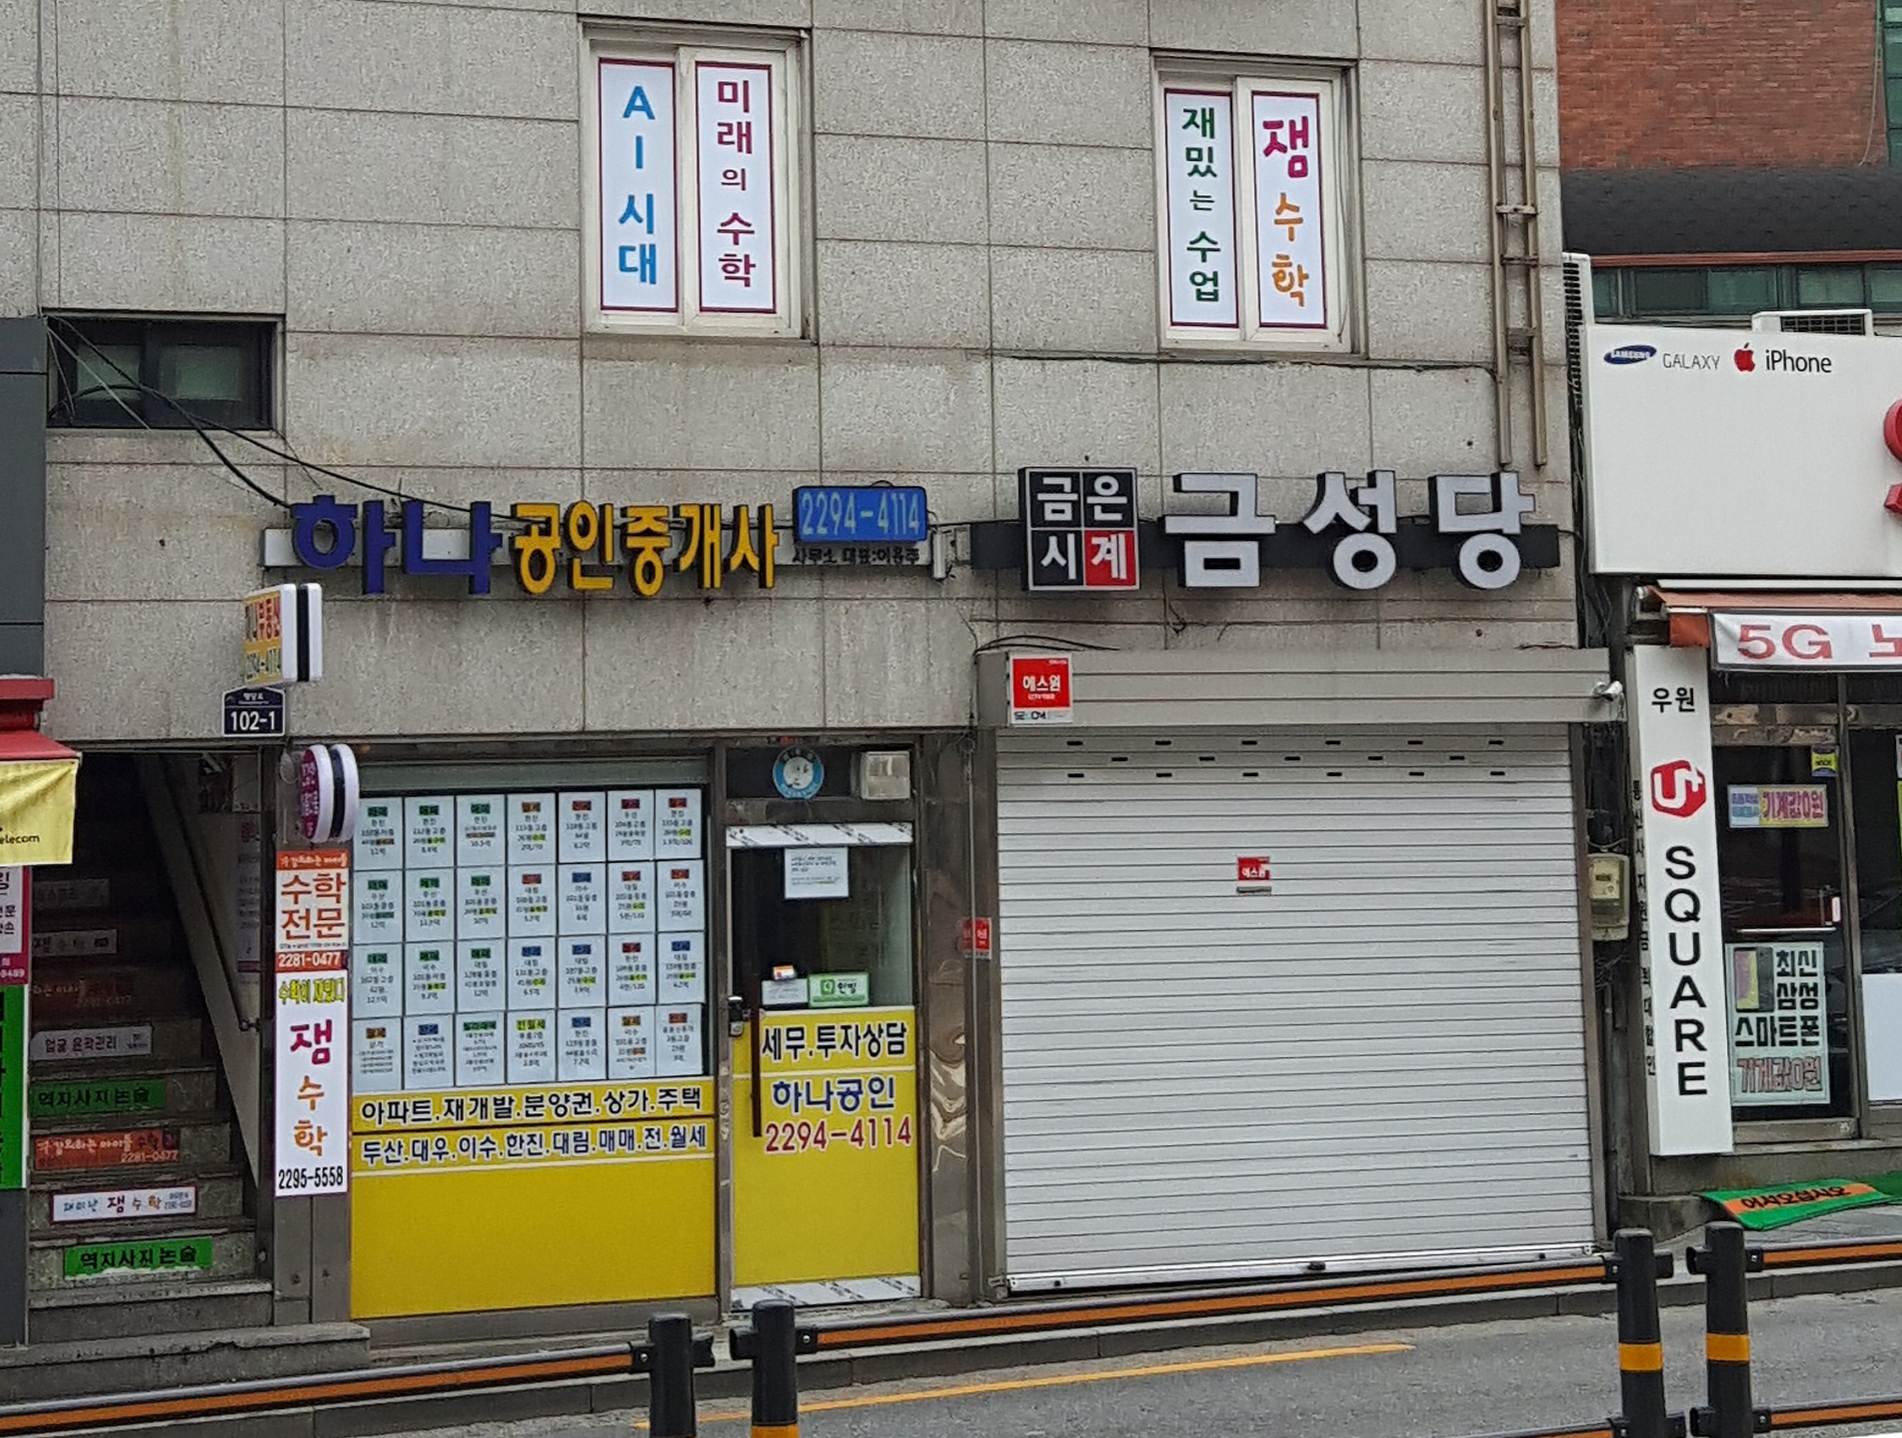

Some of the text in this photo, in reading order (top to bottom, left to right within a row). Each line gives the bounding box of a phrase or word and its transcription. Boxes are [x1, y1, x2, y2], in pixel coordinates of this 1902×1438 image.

[716, 79, 757, 288] 미래의 수학
[618, 193, 658, 286] 시대
[1186, 231, 1222, 303] 수업
[1662, 352, 1721, 371] GALAXY
[1765, 349, 1833, 374] iPhone
[801, 490, 921, 537] 2294-4114
[1036, 474, 1128, 523] 금은
[291, 493, 780, 598] 하나 공인중개사
[1158, 469, 1536, 590] 금성당
[1039, 532, 1129, 582] 시계
[1737, 623, 1833, 660] 5G
[1022, 674, 1061, 693] 에스원
[1651, 687, 1697, 714] 우원
[230, 710, 275, 732] 102-1
[280, 871, 347, 906] 수학
[280, 907, 346, 941] 전문
[278, 951, 342, 969] 2281-0477
[1663, 844, 1709, 1097] SQUARE
[1775, 949, 1819, 978] 최신
[1776, 982, 1819, 1011] 삼성
[1734, 1015, 1820, 1047] 스마트폰
[772, 1076, 896, 1113] 하나공인
[765, 1116, 912, 1153] 2294-4114
[277, 1164, 344, 1190] 2295-5558
